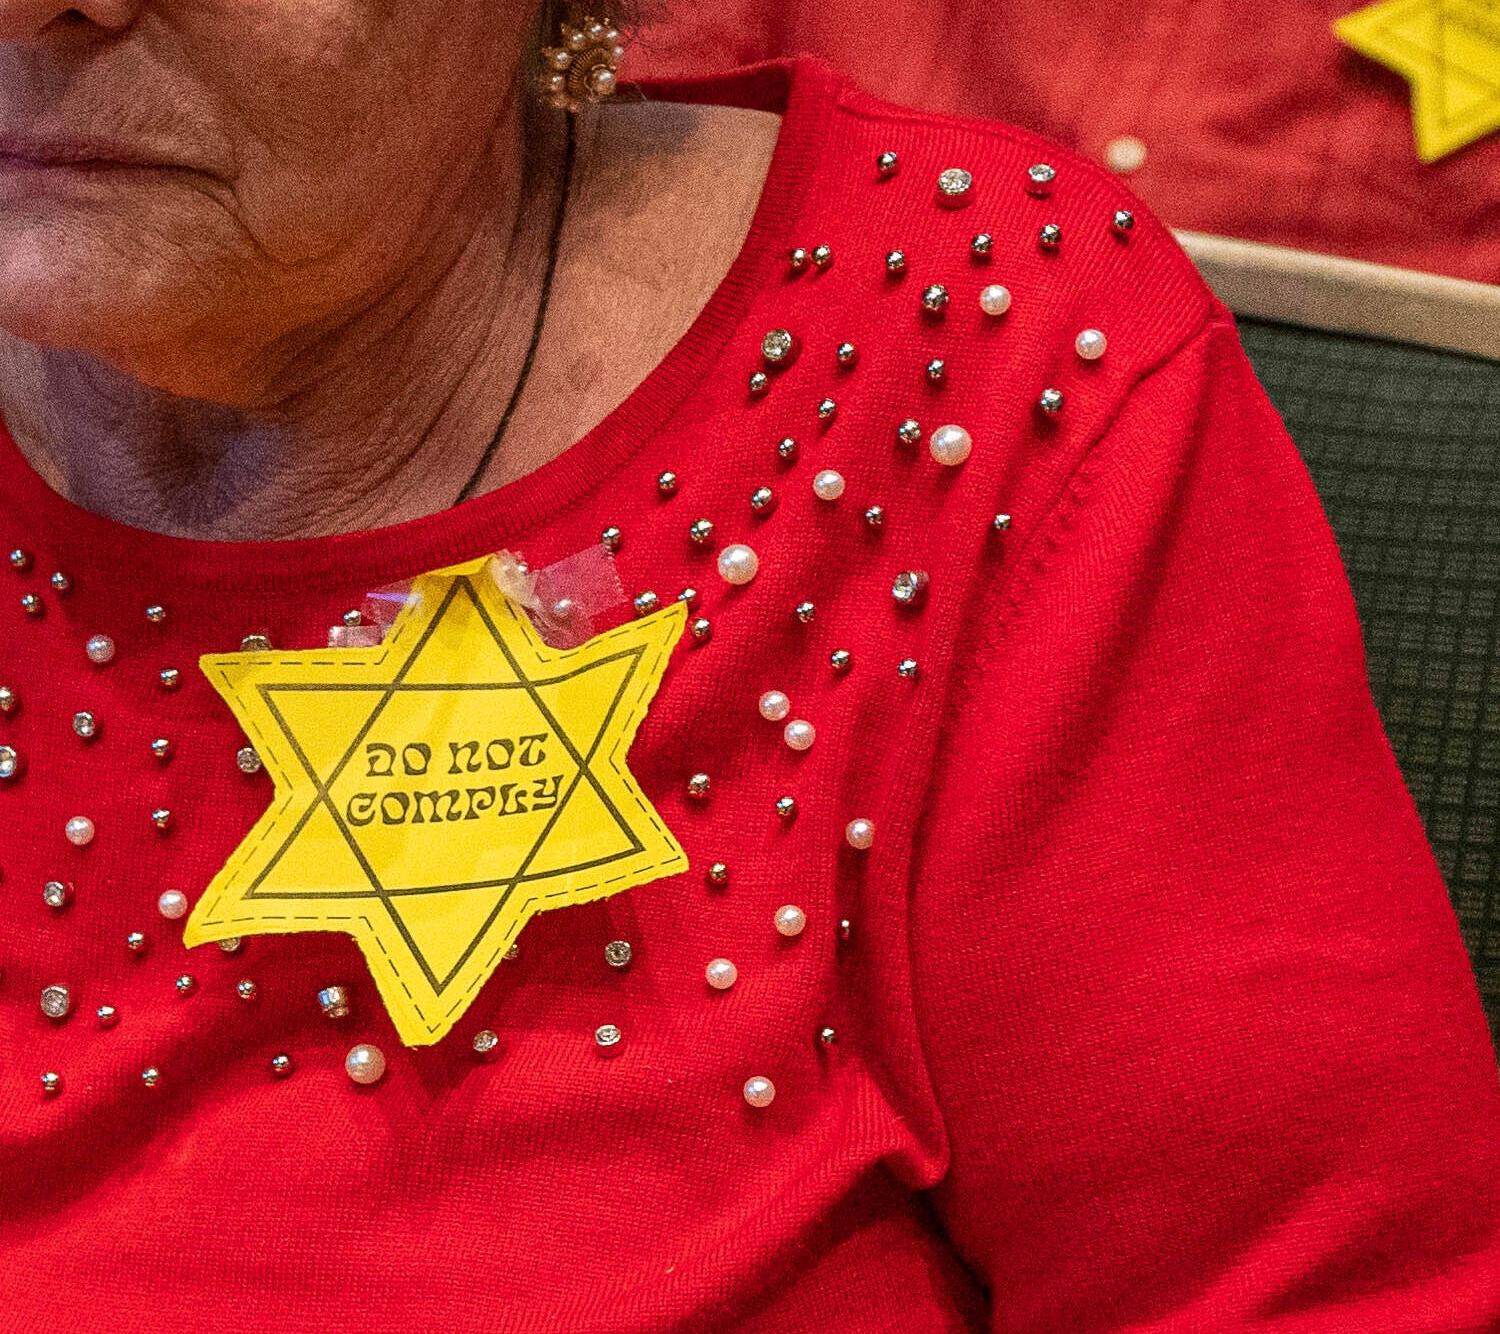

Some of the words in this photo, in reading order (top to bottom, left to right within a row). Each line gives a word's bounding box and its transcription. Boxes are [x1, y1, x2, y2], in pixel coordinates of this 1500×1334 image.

[366, 742, 432, 776] DO
[448, 733, 548, 774] NOT
[346, 774, 565, 827] COMPLY
